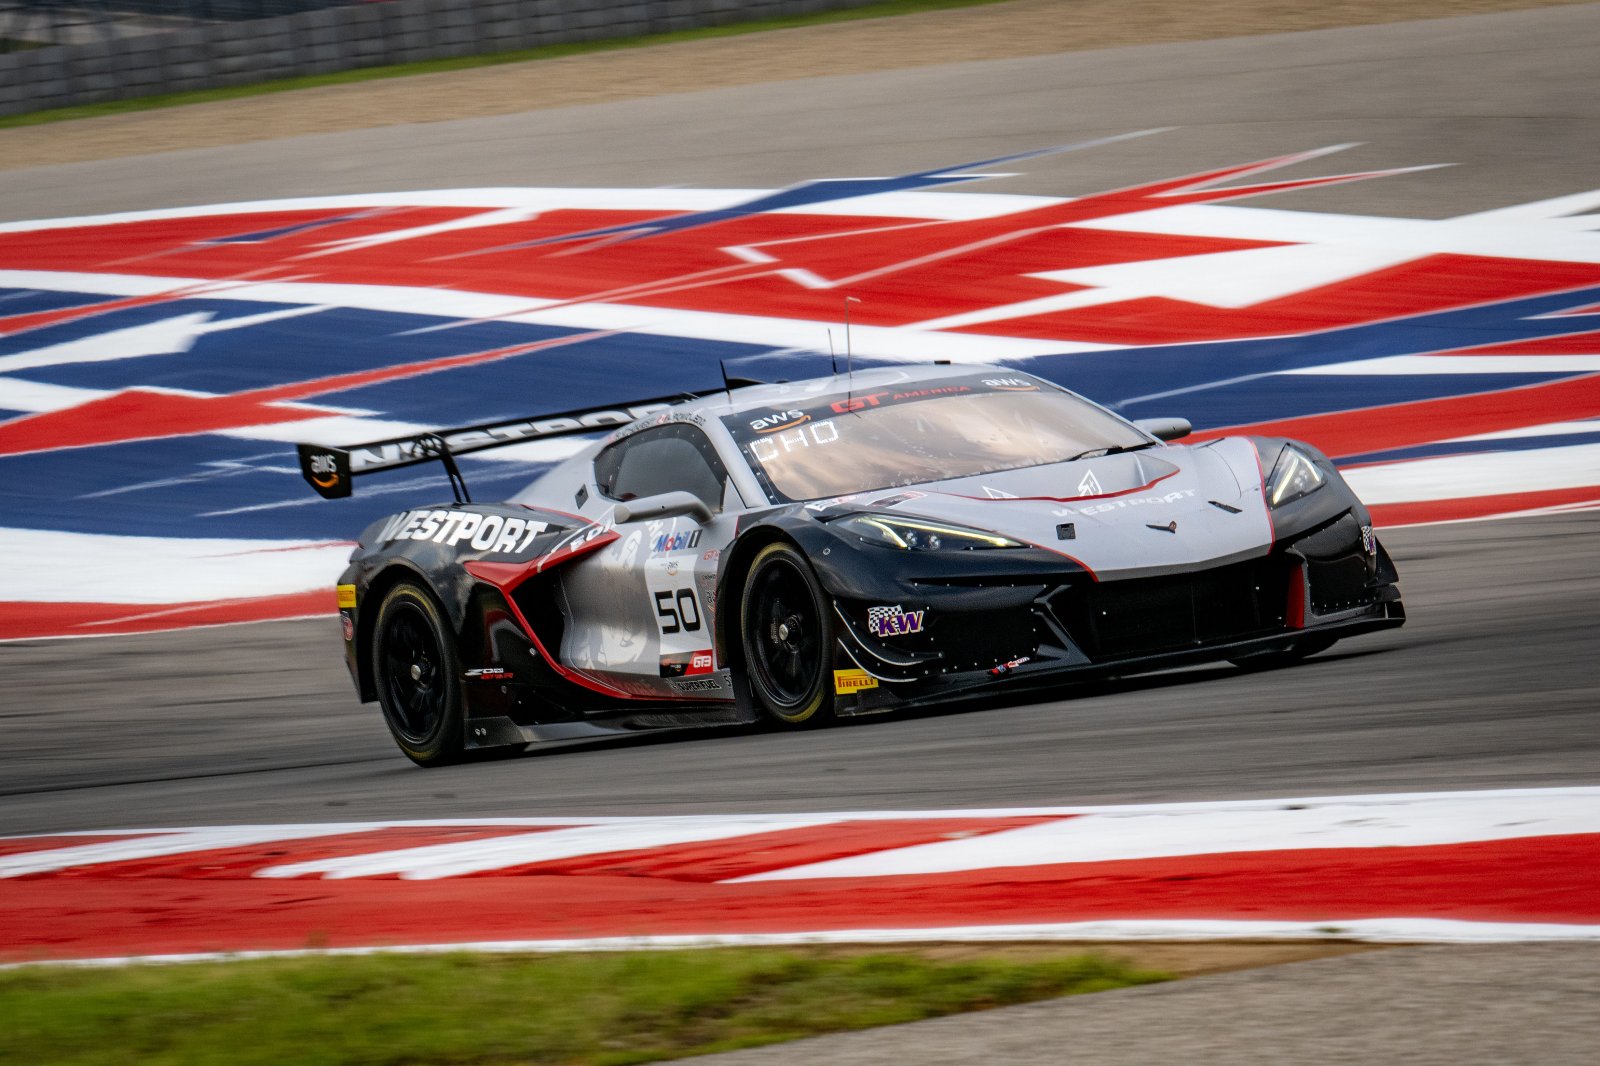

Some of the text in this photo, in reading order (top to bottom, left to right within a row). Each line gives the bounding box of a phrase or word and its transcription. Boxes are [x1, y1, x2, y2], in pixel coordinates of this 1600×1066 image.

[981, 378, 1033, 387] aws
[829, 385, 971, 413] GT AMERICA
[749, 409, 804, 430] aws
[749, 420, 839, 463] CHO
[310, 454, 337, 474] aws
[1051, 488, 1195, 517] WESTPORT
[375, 509, 549, 554] WESTPORT
[655, 531, 690, 552] Mobil
[655, 587, 701, 634] 50
[878, 610, 924, 637] KW
[693, 655, 712, 668] GT3
[837, 675, 875, 688] PIRELLI
